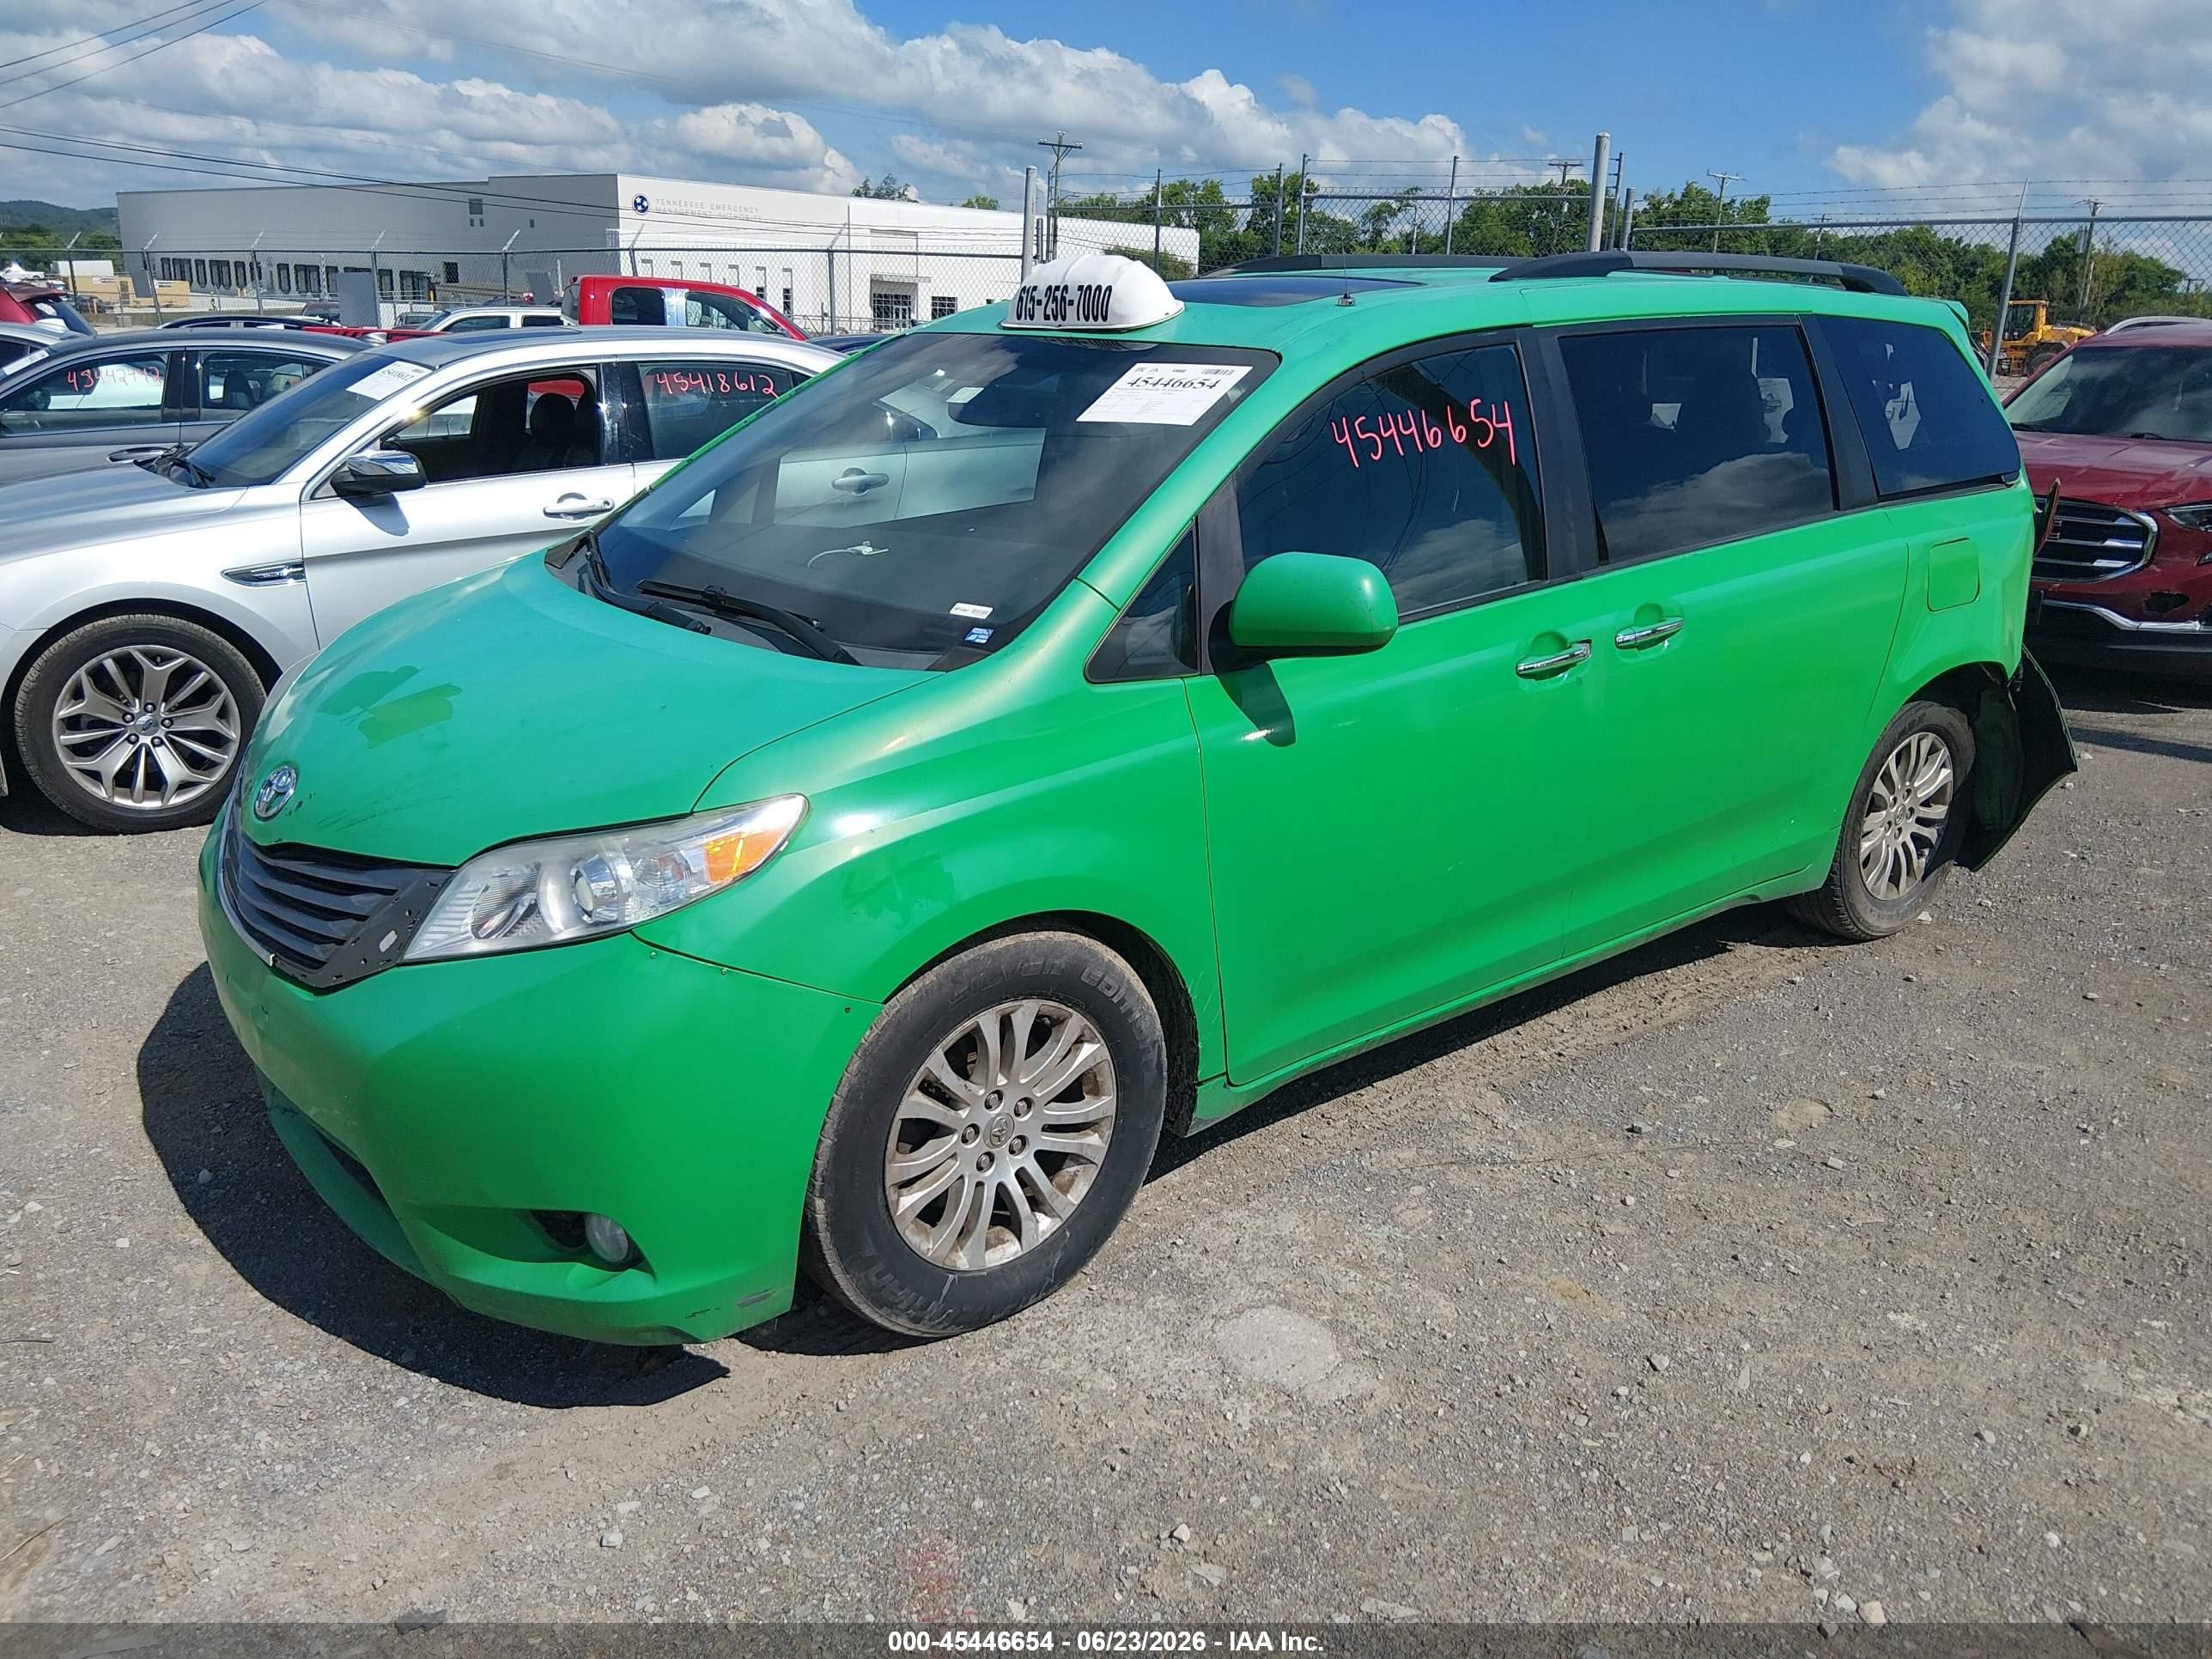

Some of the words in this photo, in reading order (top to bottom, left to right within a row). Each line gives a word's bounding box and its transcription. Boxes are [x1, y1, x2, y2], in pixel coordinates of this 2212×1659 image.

[655, 198, 705, 210] TENNESSEE
[710, 203, 760, 214] EMERGENCY
[1015, 284, 1113, 323] 615-256-7000
[656, 371, 780, 399] 45418612
[1127, 376, 1223, 390] 45446654
[1331, 398, 1516, 469] 45446654
